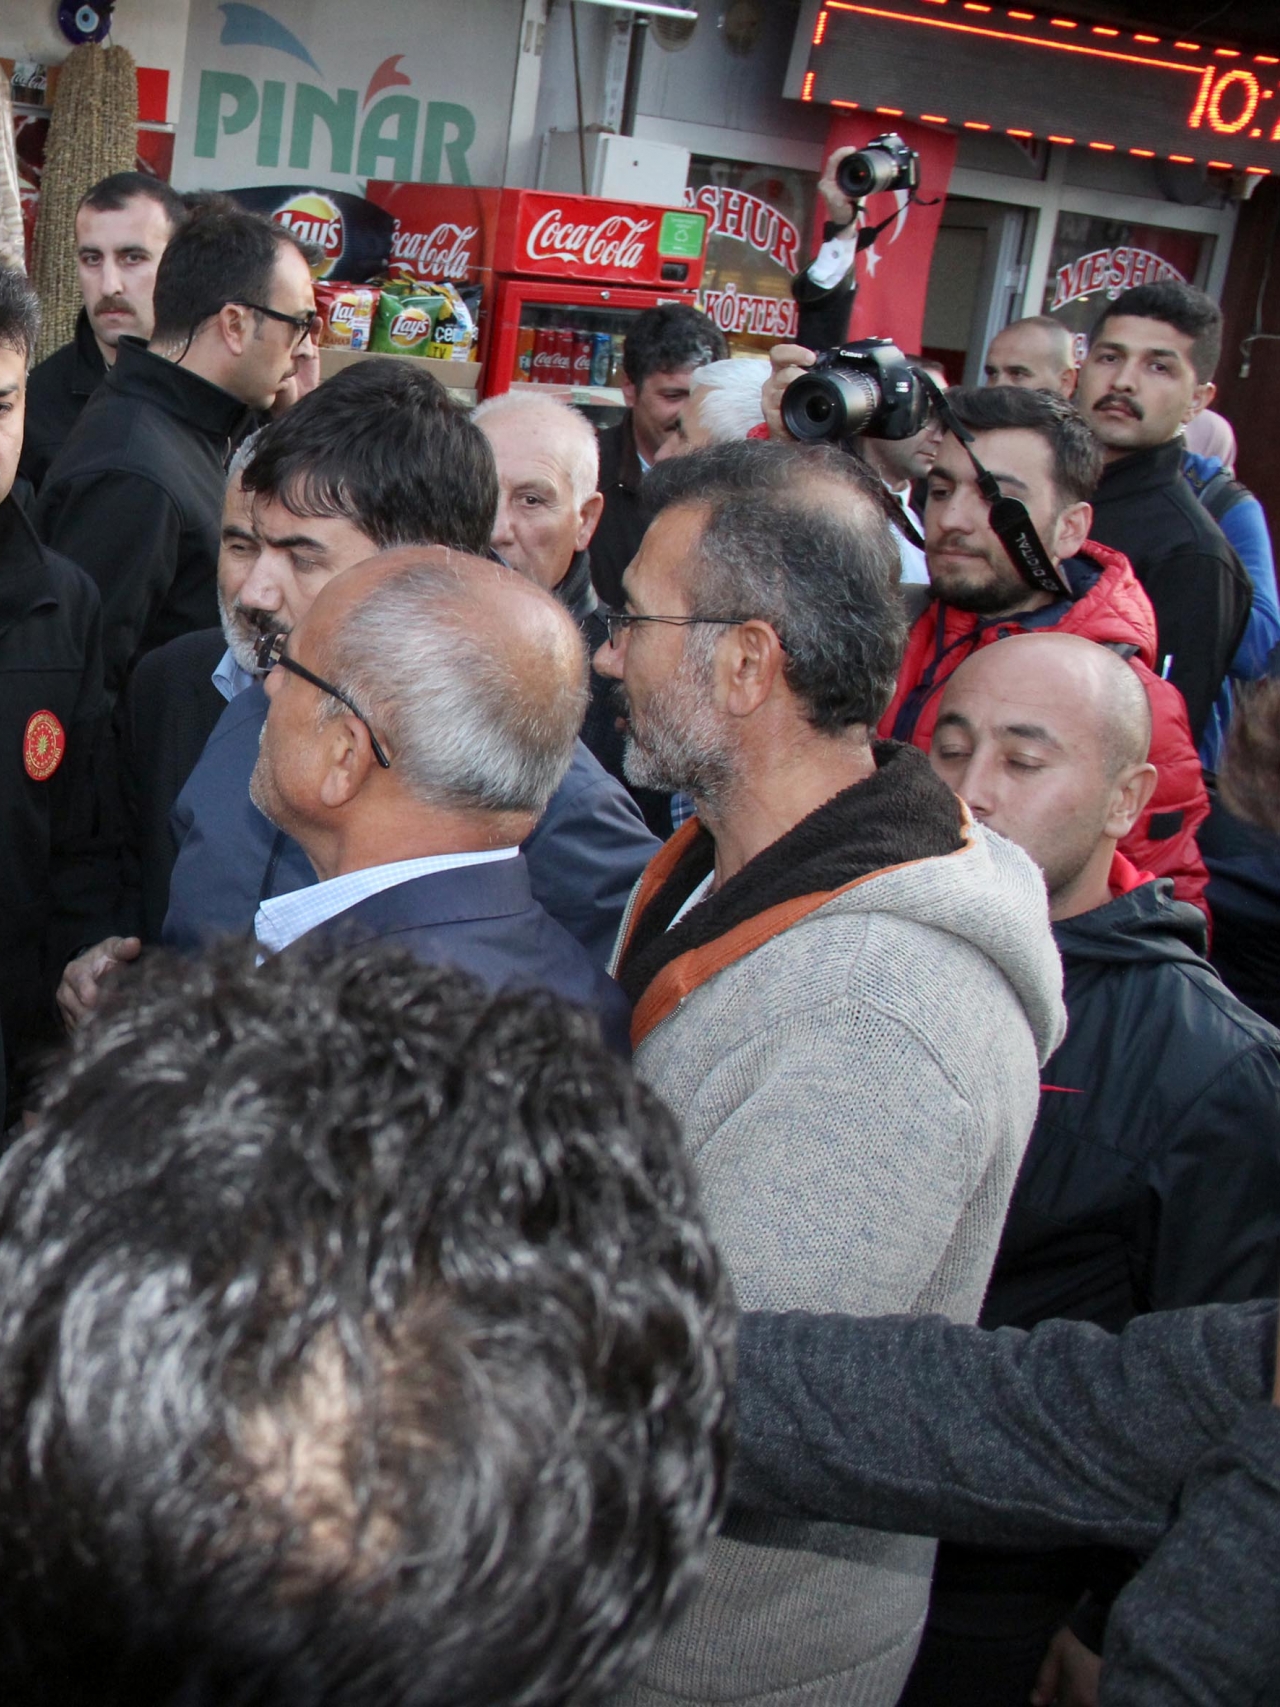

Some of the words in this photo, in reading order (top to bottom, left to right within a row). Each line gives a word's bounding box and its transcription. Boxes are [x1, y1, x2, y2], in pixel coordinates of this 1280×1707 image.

[1187, 64, 1280, 141] 10:
[389, 217, 479, 280] oca-Cola
[526, 208, 656, 269] Coca-Cola
[1050, 246, 1188, 312] MEŞHU
